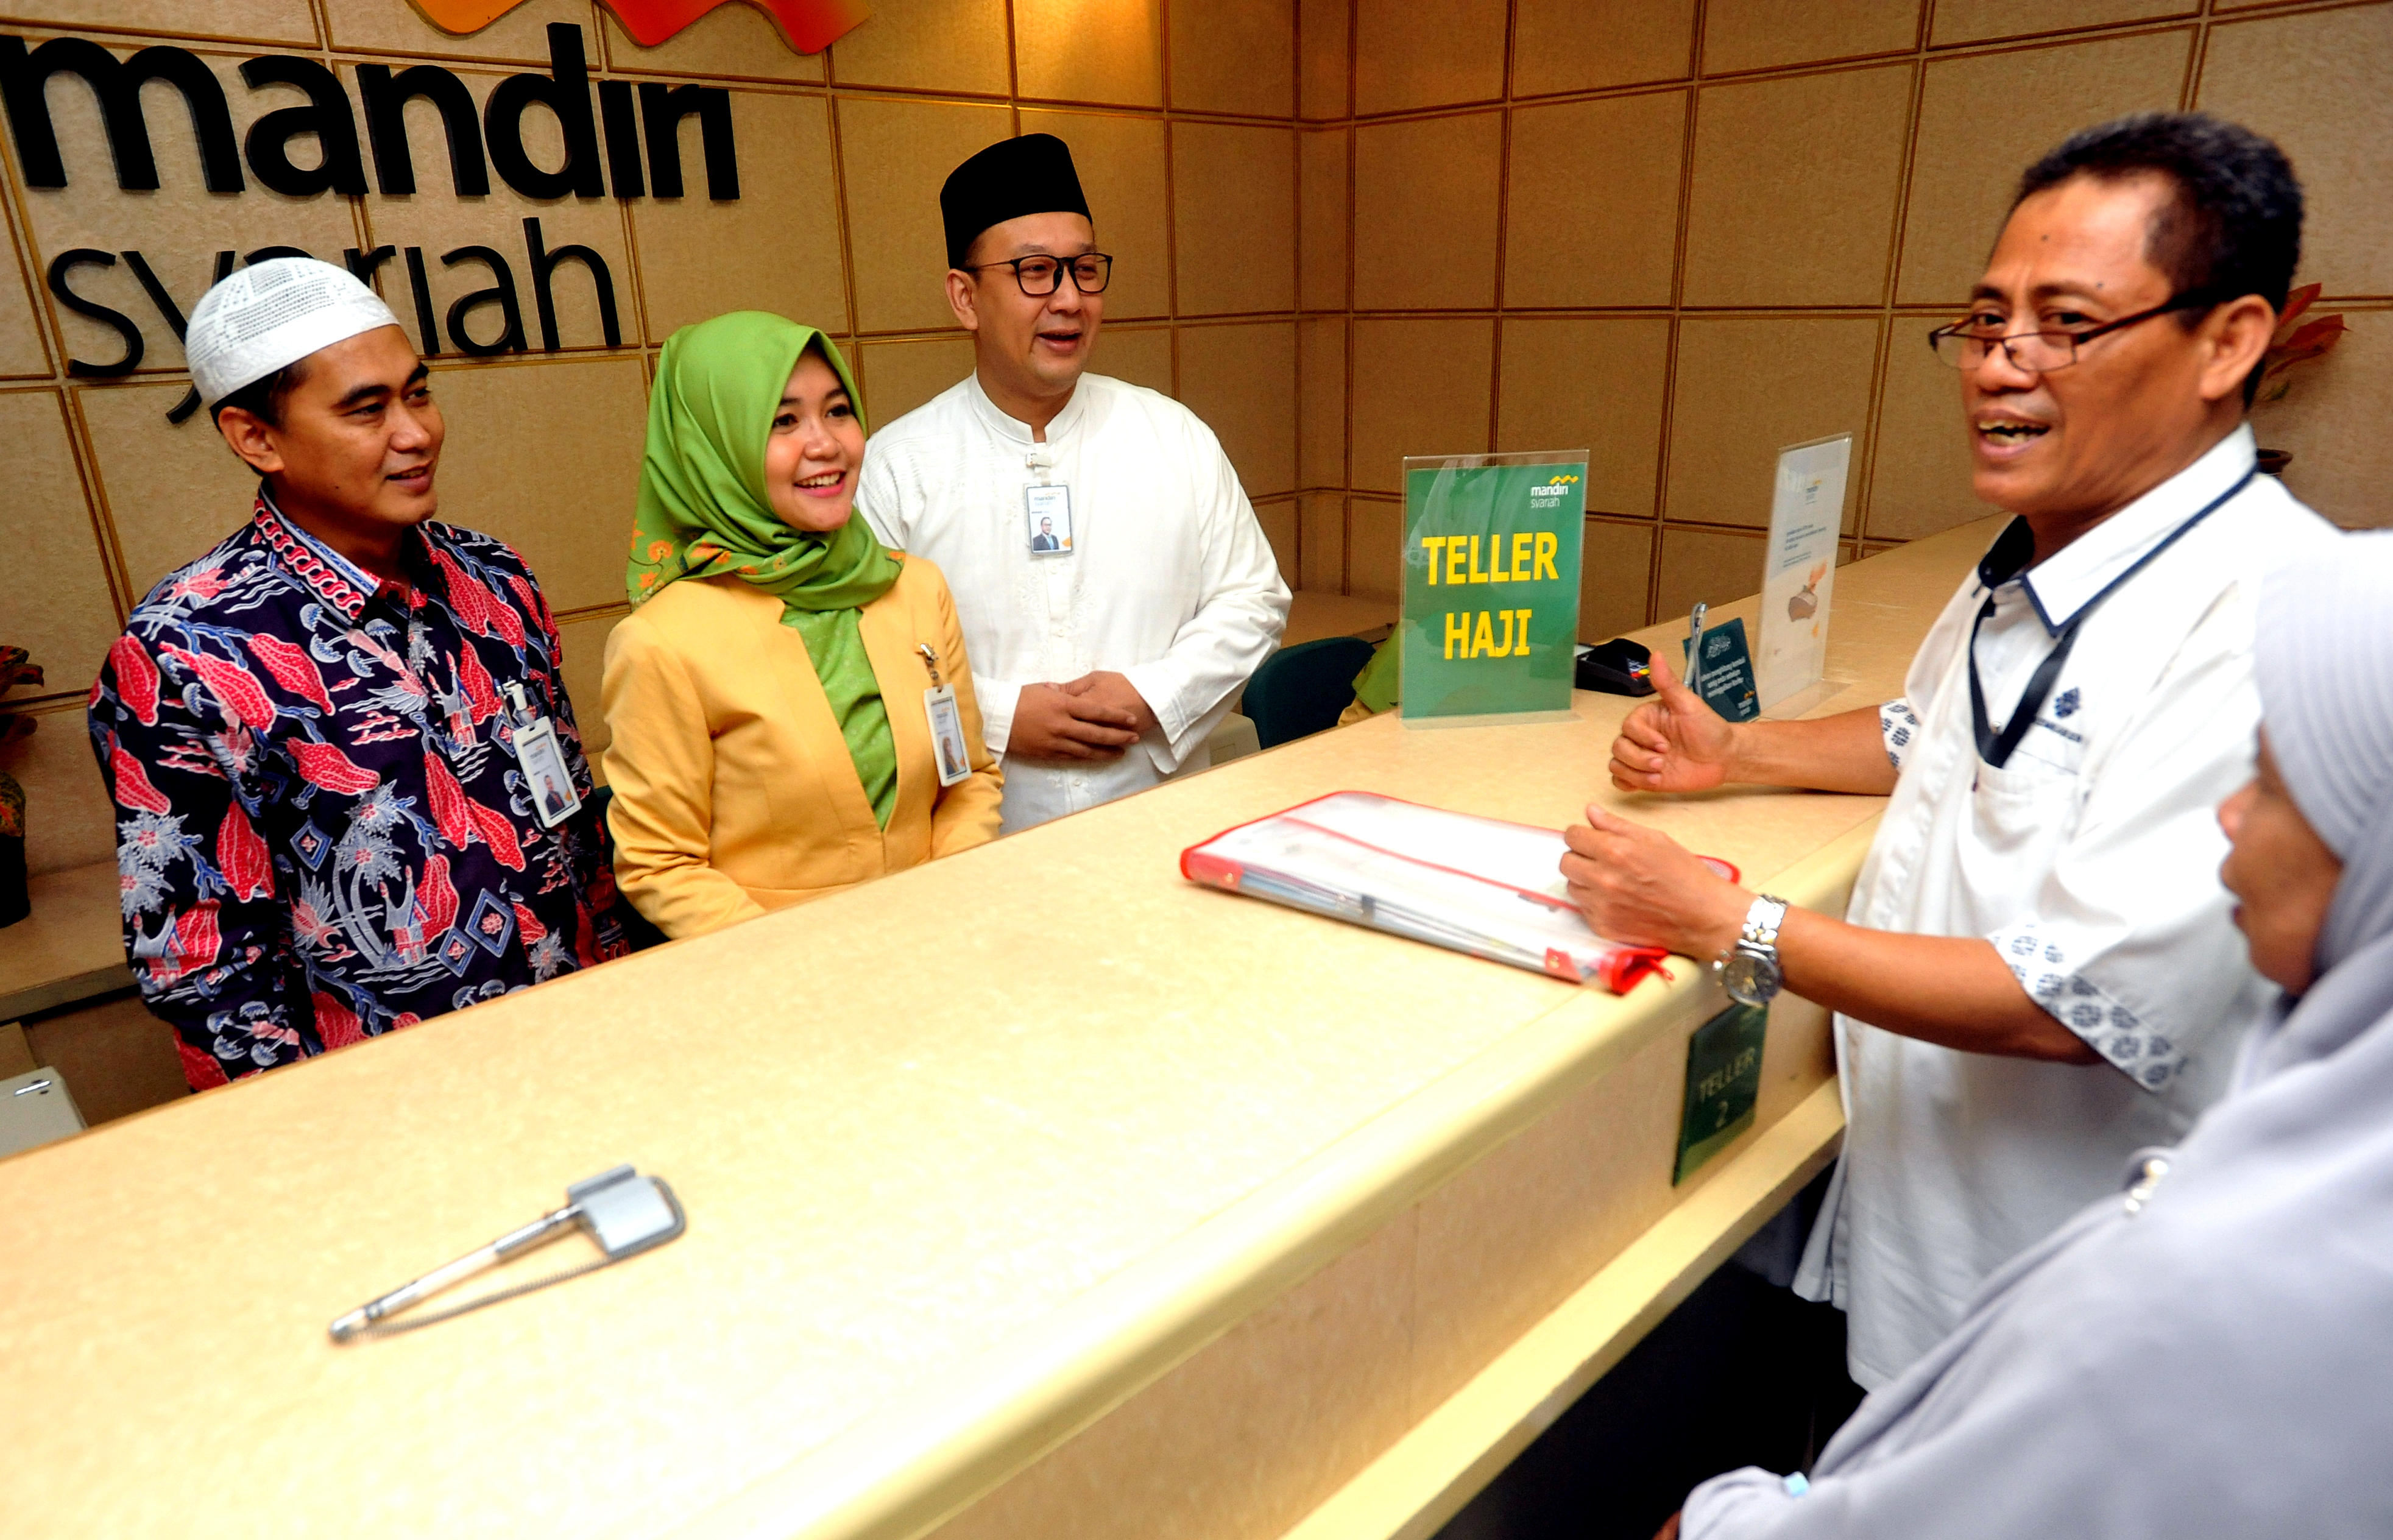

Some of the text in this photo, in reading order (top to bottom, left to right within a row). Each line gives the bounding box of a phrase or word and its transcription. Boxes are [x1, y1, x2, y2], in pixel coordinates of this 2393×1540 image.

[0, 23, 740, 200] mandiri
[48, 217, 621, 425] syriah
[1530, 482, 1569, 496] mandiri
[1530, 496, 1561, 509] syariah
[1422, 532, 1559, 585] TELLER
[1444, 609, 1532, 660] HAJI
